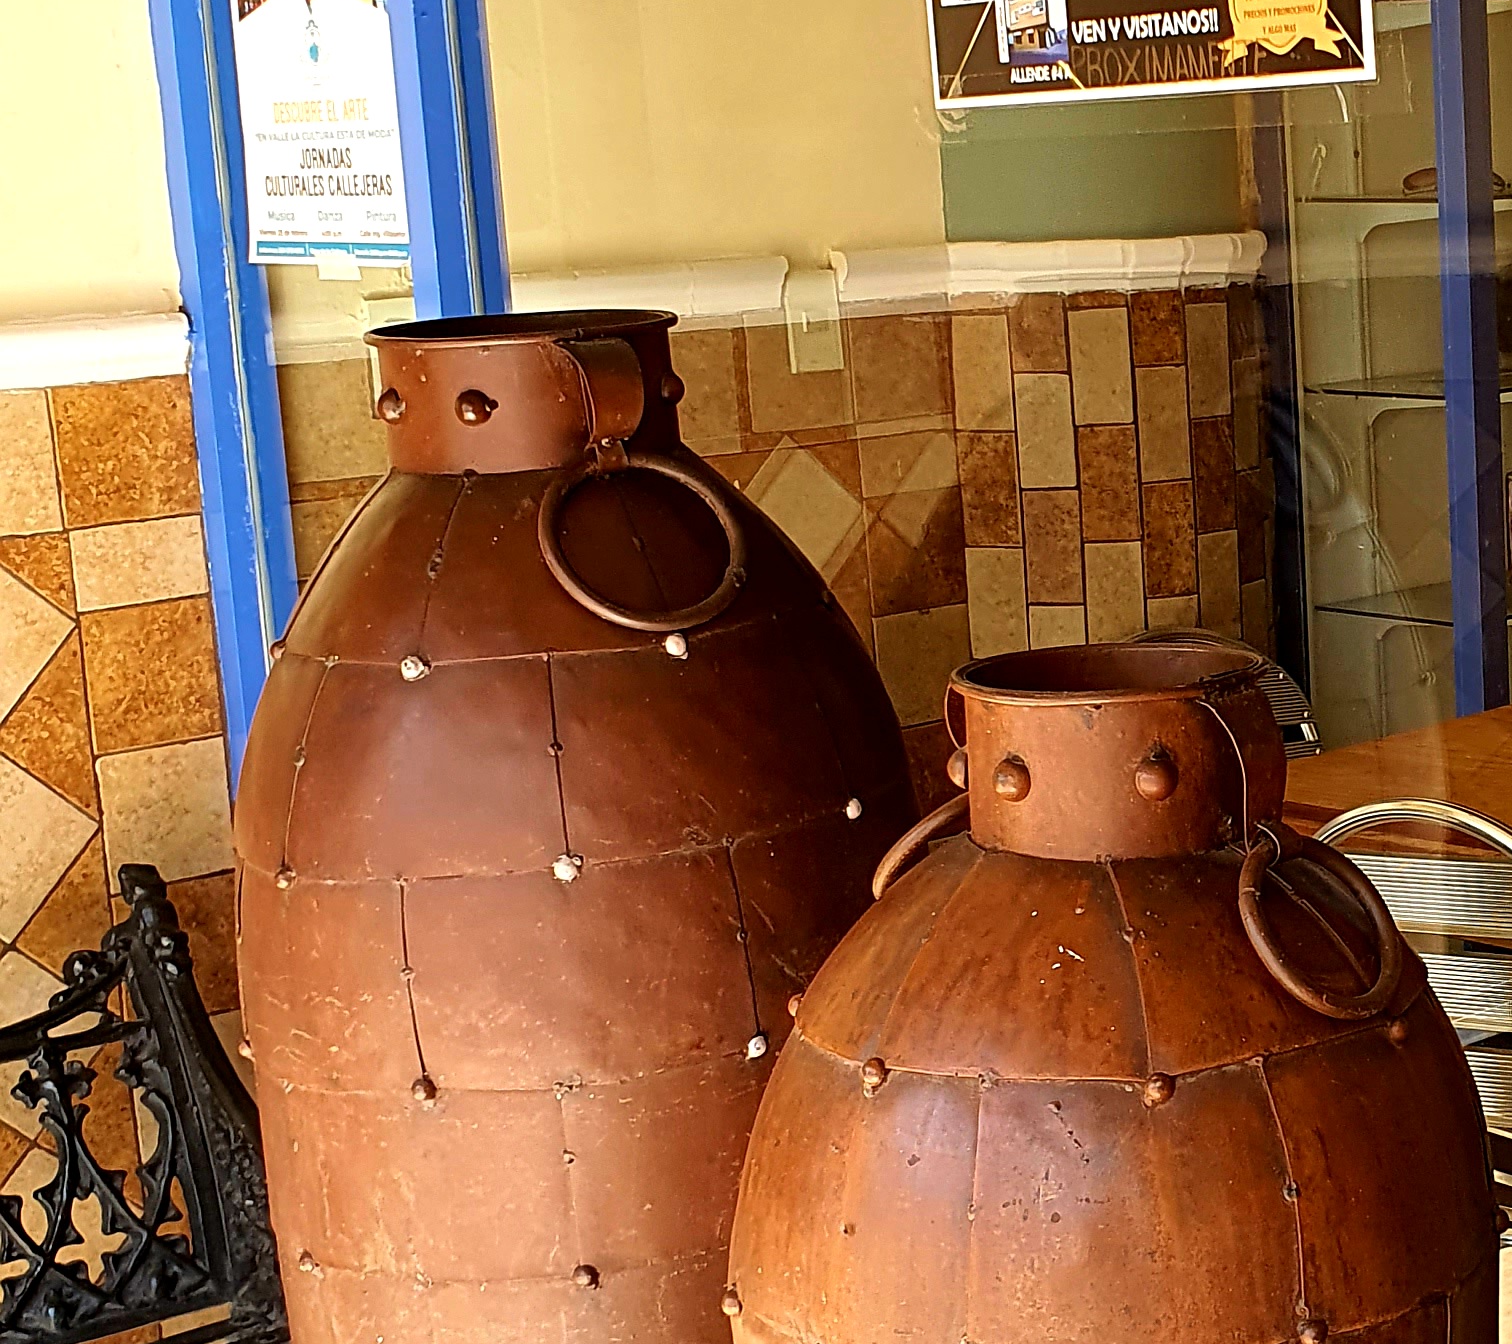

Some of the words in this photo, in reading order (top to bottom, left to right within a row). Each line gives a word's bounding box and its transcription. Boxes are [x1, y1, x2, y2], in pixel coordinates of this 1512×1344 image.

[1072, 18, 1106, 44] VEN
[1107, 16, 1121, 41] Y
[1121, 7, 1219, 39] VISITANOS!!
[1010, 65, 1051, 84] ALLENDE
[300, 147, 352, 169] JORNADAS
[265, 175, 325, 196] CULTURALES
[328, 174, 392, 197] CALLEJERAS
